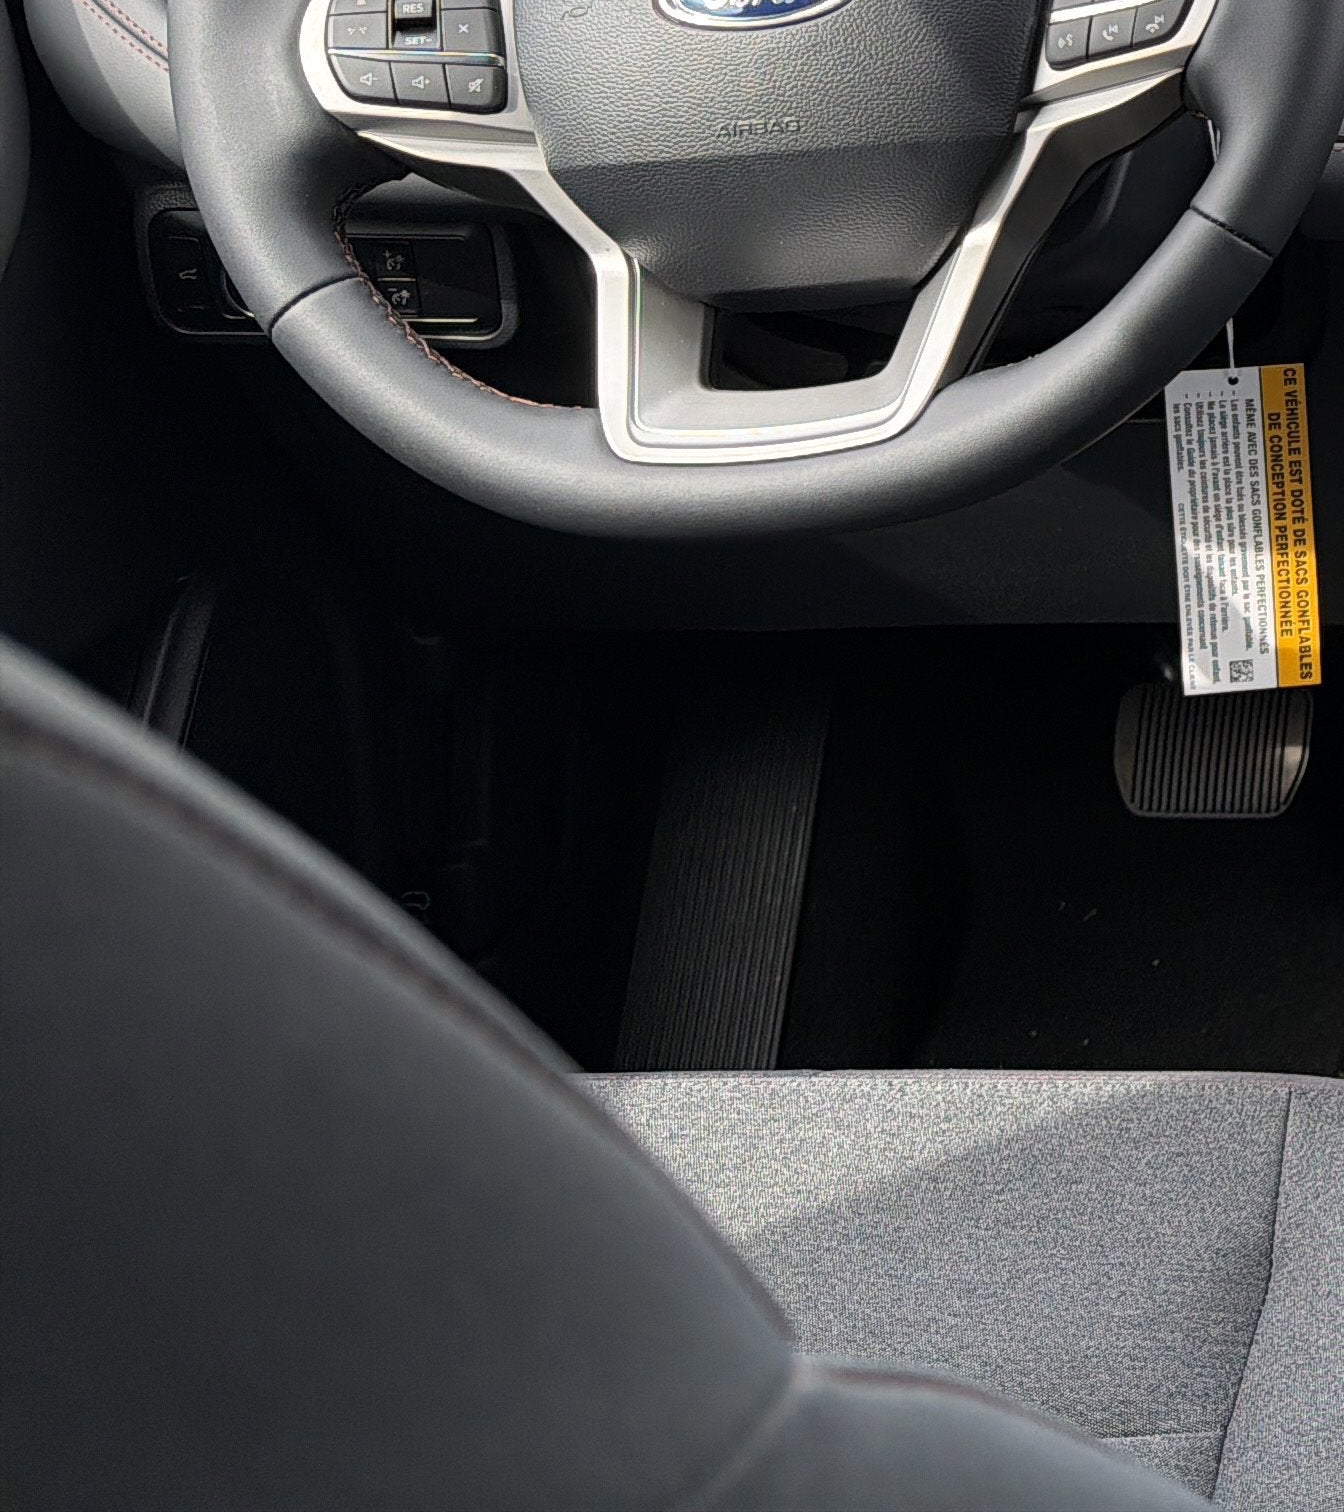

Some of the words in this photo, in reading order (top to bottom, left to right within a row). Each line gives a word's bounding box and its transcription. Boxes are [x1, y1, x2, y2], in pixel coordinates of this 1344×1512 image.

[402, 3, 423, 14] RES
[717, 120, 801, 138] AIRBAG
[1283, 367, 1297, 385] CE
[1230, 399, 1238, 411] Les
[1244, 398, 1257, 428] MÊME
[1173, 415, 1181, 432] sacs
[1217, 410, 1228, 429] siège
[1231, 413, 1240, 439] enfants
[1267, 411, 1281, 430] DE
[1284, 389, 1303, 455] VÉHICULE
[1220, 431, 1230, 454] arrière
[1231, 441, 1241, 469] peuvent
[1246, 430, 1257, 455] AVEC
[1222, 455, 1230, 466] est
[1248, 458, 1258, 477] DES
[1288, 459, 1302, 484] EST
[1222, 477, 1231, 495] place
[1235, 470, 1243, 484] être
[1269, 434, 1286, 521] CONCEPTION
[1250, 480, 1260, 505] SACS
[1177, 502, 1185, 524] CETTE
[1237, 503, 1243, 512] ou
[1290, 488, 1308, 524] DOTÉ
[1237, 514, 1247, 539] blessés
[1292, 528, 1306, 546] DE
[1251, 508, 1264, 571] GONFLABLES
[1238, 541, 1249, 577] gravement
[1293, 550, 1308, 585] SACS
[1274, 524, 1296, 637] PERFECTIONNÉE
[1255, 573, 1270, 654] PERFECTIONNÉS
[1295, 589, 1313, 680] GONFLABLES
